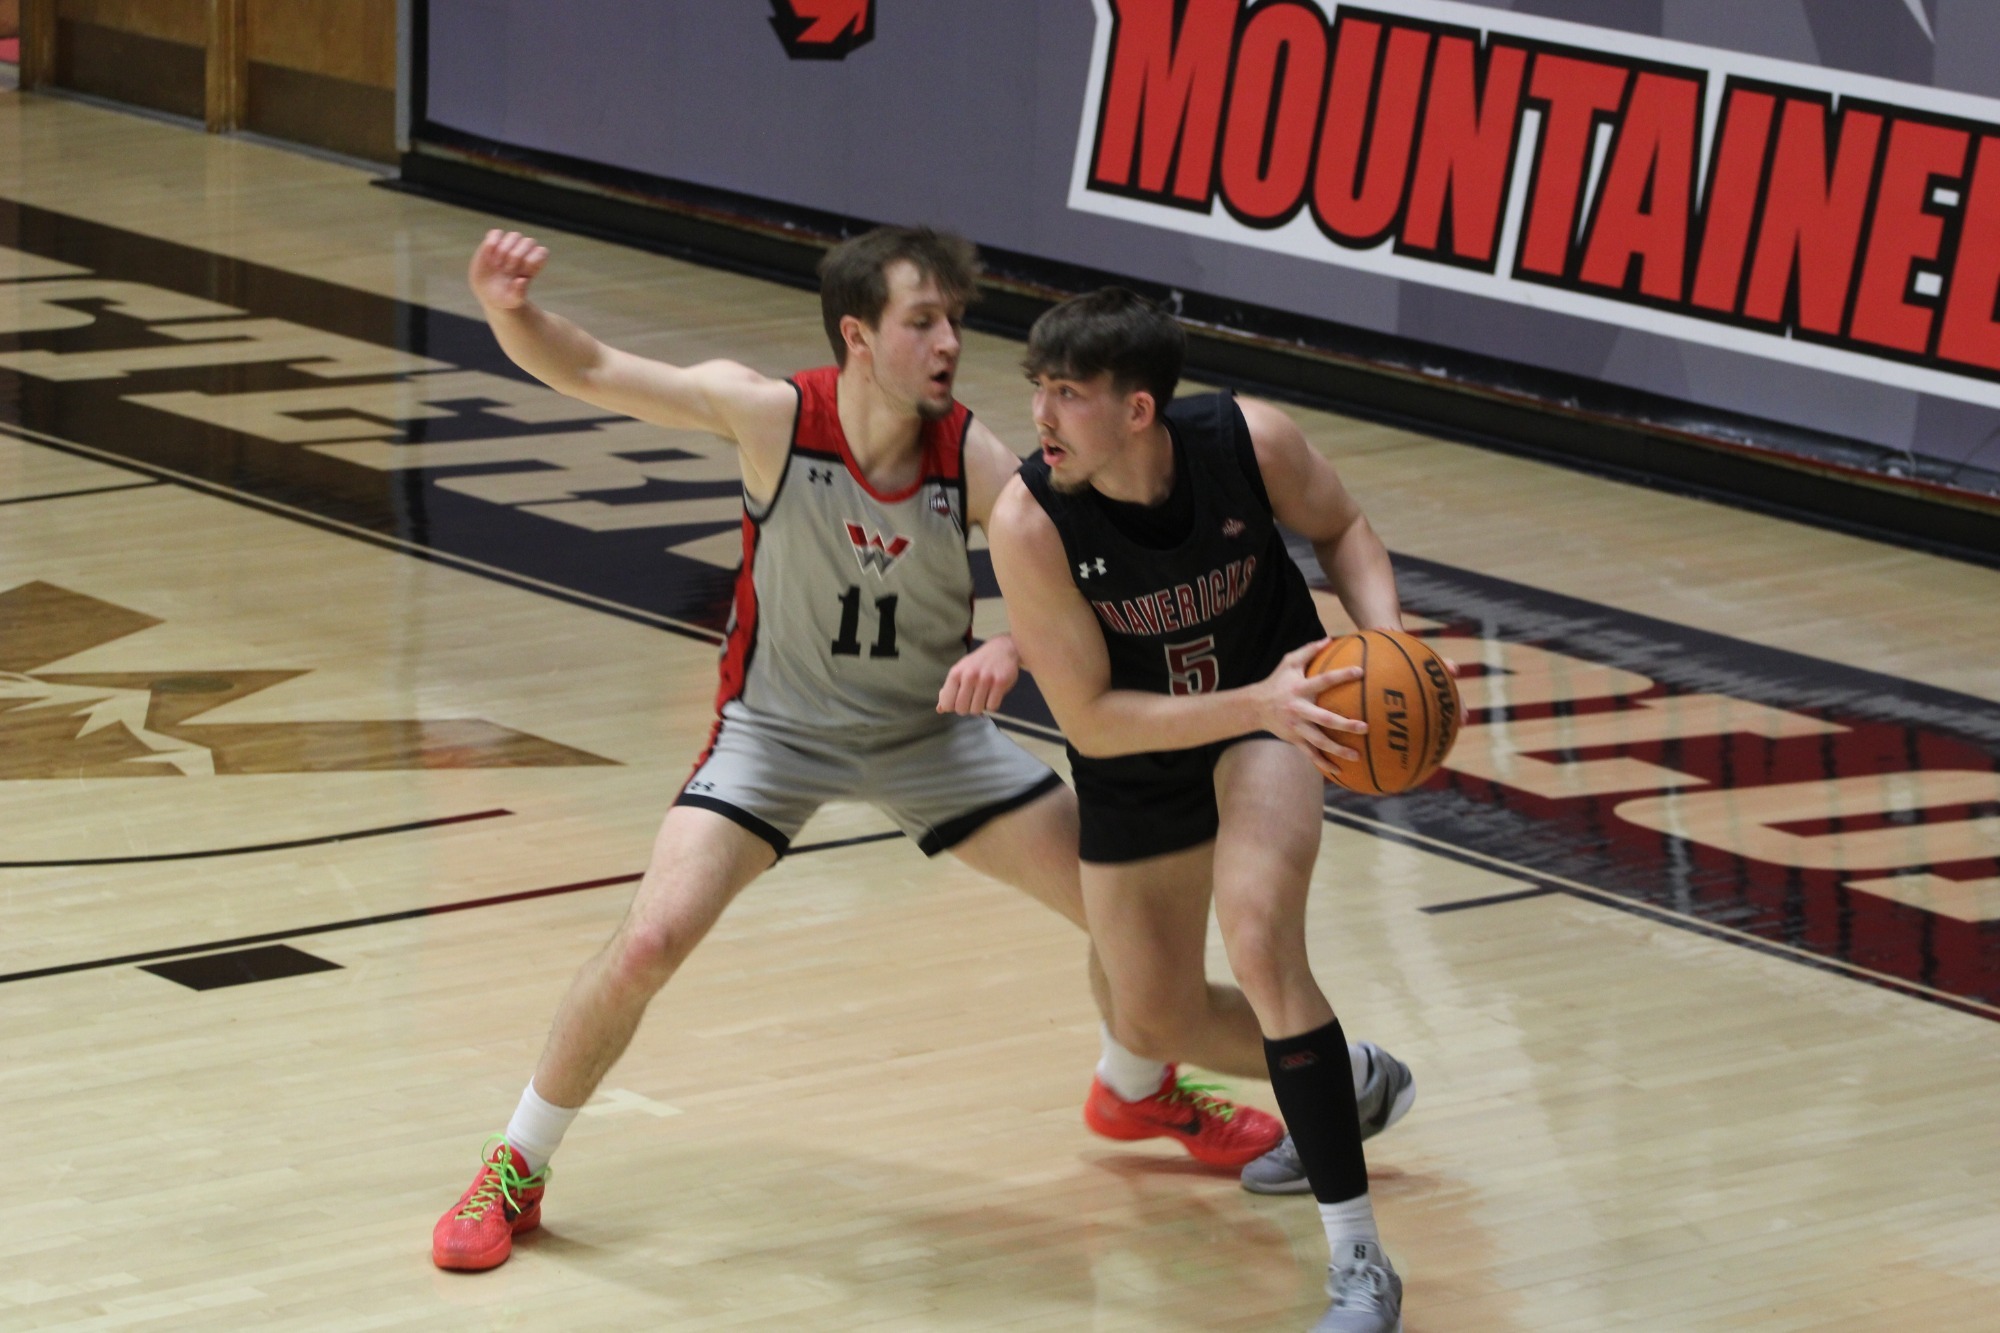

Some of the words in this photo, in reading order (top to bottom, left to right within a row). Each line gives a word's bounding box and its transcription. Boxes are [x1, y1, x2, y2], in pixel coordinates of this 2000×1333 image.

[843, 518, 913, 581] W
[831, 585, 899, 658] 11
[1092, 555, 1256, 636] MAVERICKS
[1164, 634, 1219, 697] 5
[1383, 687, 1410, 752] EVO
